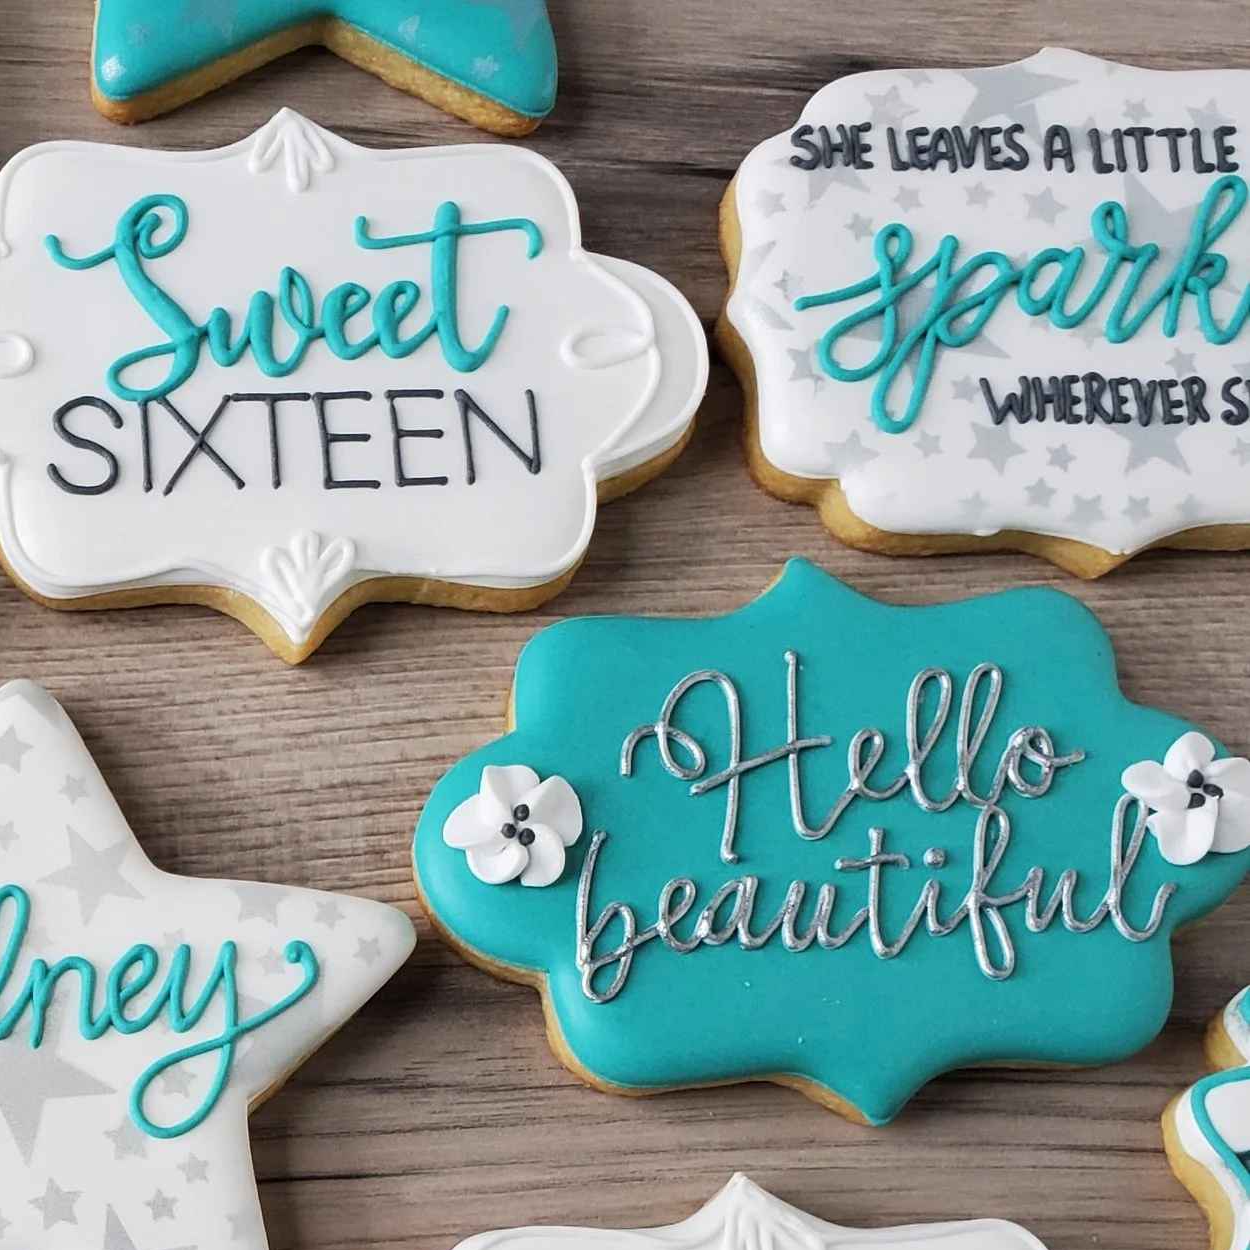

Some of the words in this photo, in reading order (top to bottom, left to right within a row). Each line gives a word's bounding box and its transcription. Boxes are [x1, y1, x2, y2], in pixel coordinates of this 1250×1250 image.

[789, 122, 874, 171] SHE
[886, 123, 1031, 174] LEAVES
[1043, 124, 1075, 174] A
[1086, 125, 1240, 174] LITTLE
[44, 193, 544, 402] Sweet
[47, 388, 543, 497] SIXTEEN
[978, 371, 1211, 428] WHEREVER
[1220, 376, 1250, 426] S
[619, 650, 1085, 864] Hello
[575, 793, 1176, 1003] beautiful
